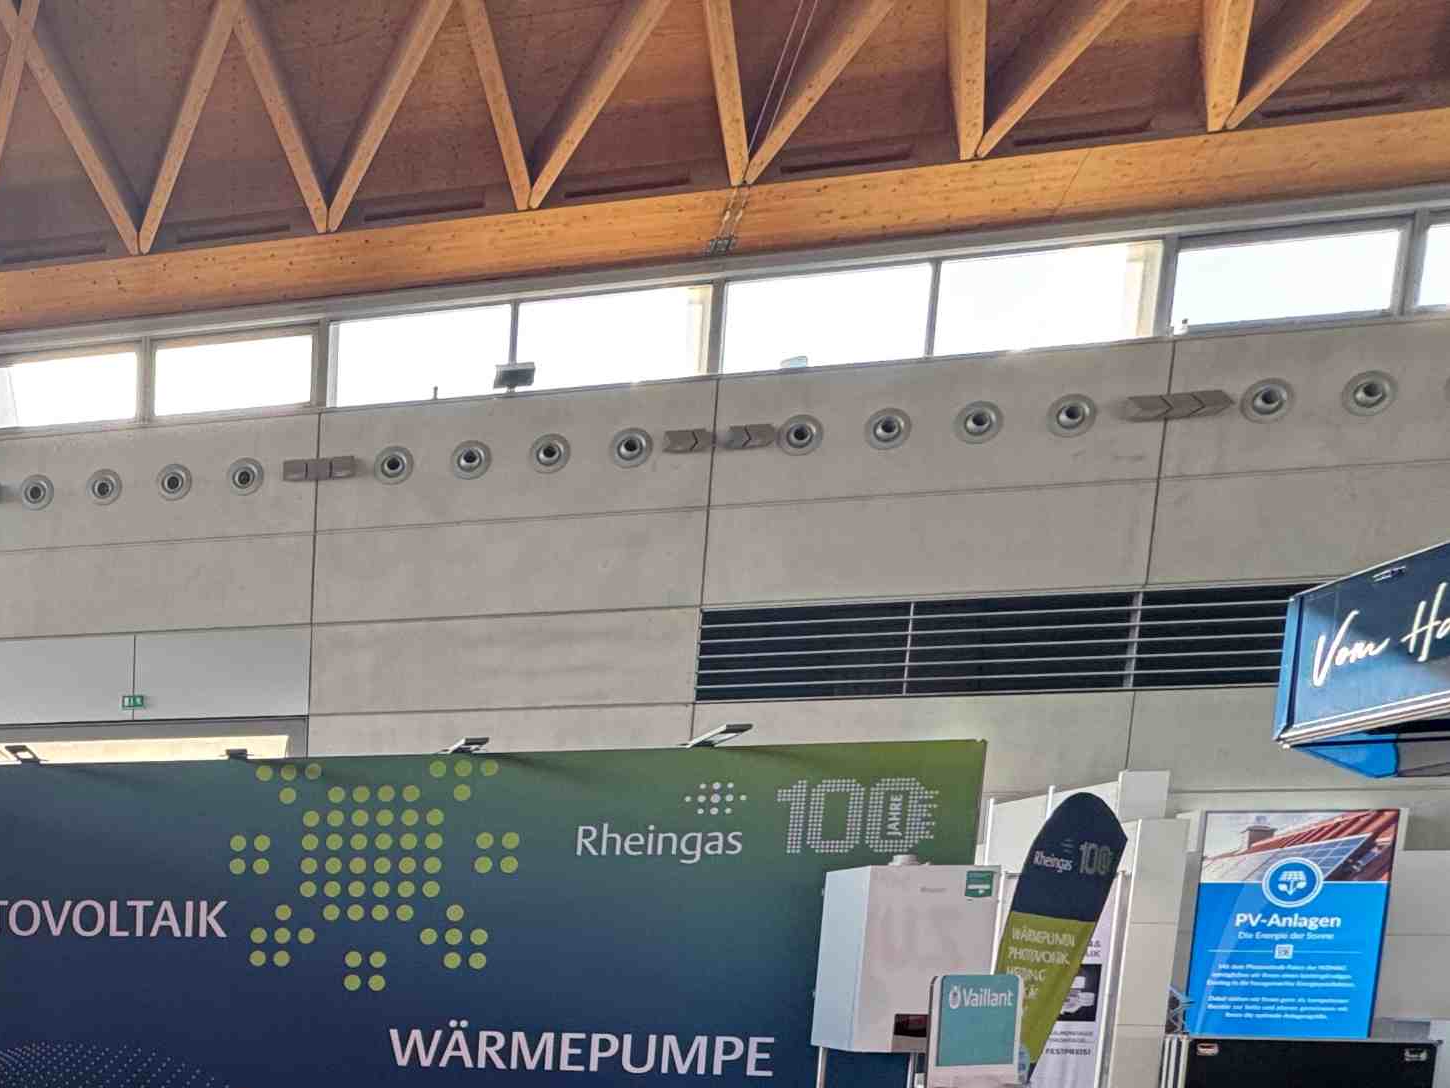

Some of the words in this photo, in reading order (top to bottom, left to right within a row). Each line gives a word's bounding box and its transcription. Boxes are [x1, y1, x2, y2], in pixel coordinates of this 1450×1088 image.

[575, 823, 743, 864] Rheingas
[776, 777, 940, 854] 100
[887, 793, 904, 838] JAHRE
[1033, 850, 1073, 874] Rheingas
[1234, 912, 1342, 930] PV-Anlagen
[962, 986, 1014, 1008] Vaillant
[388, 1019, 775, 1077] WÄRMEPUMPE
